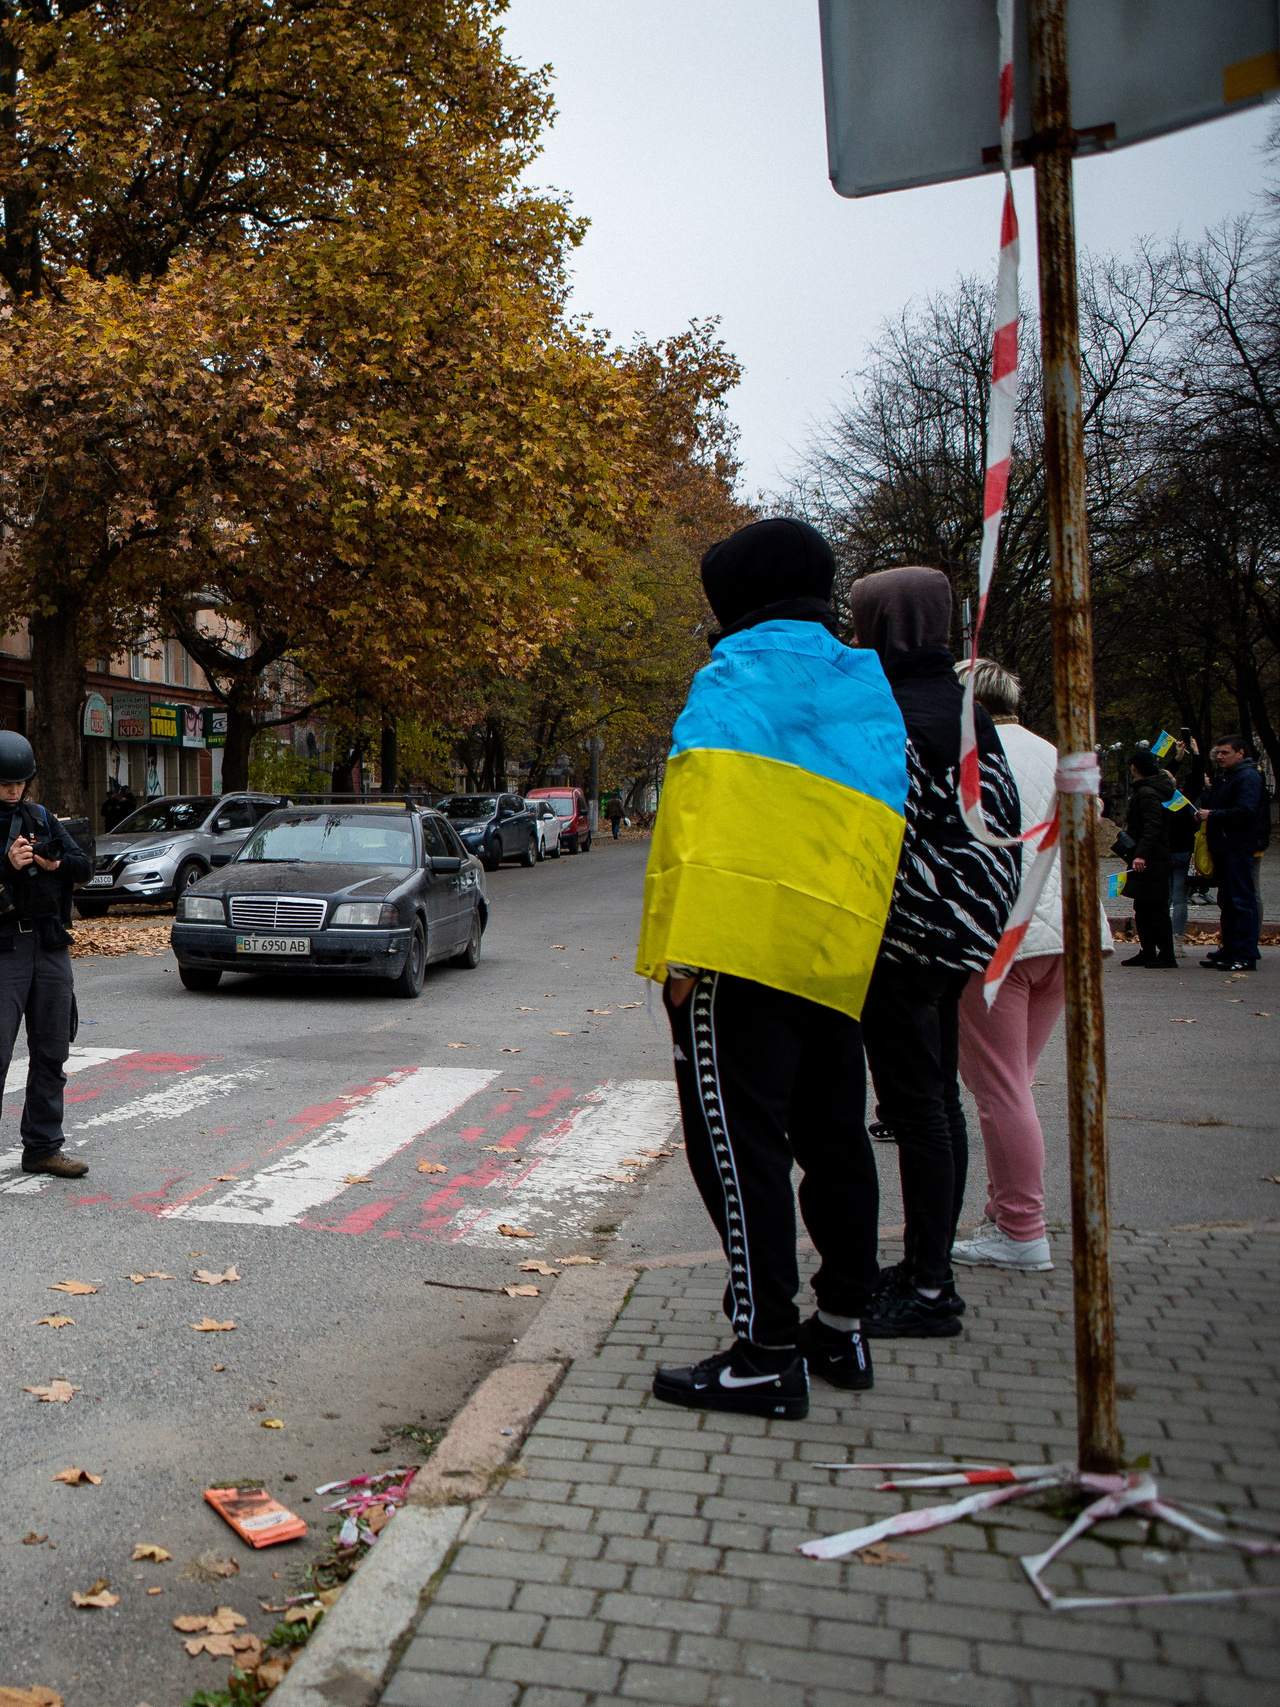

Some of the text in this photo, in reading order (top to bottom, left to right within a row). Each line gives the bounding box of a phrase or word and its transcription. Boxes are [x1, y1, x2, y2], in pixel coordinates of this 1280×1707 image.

[119, 726, 144, 736] KIDS
[243, 939, 306, 952] BT 6950 AB
